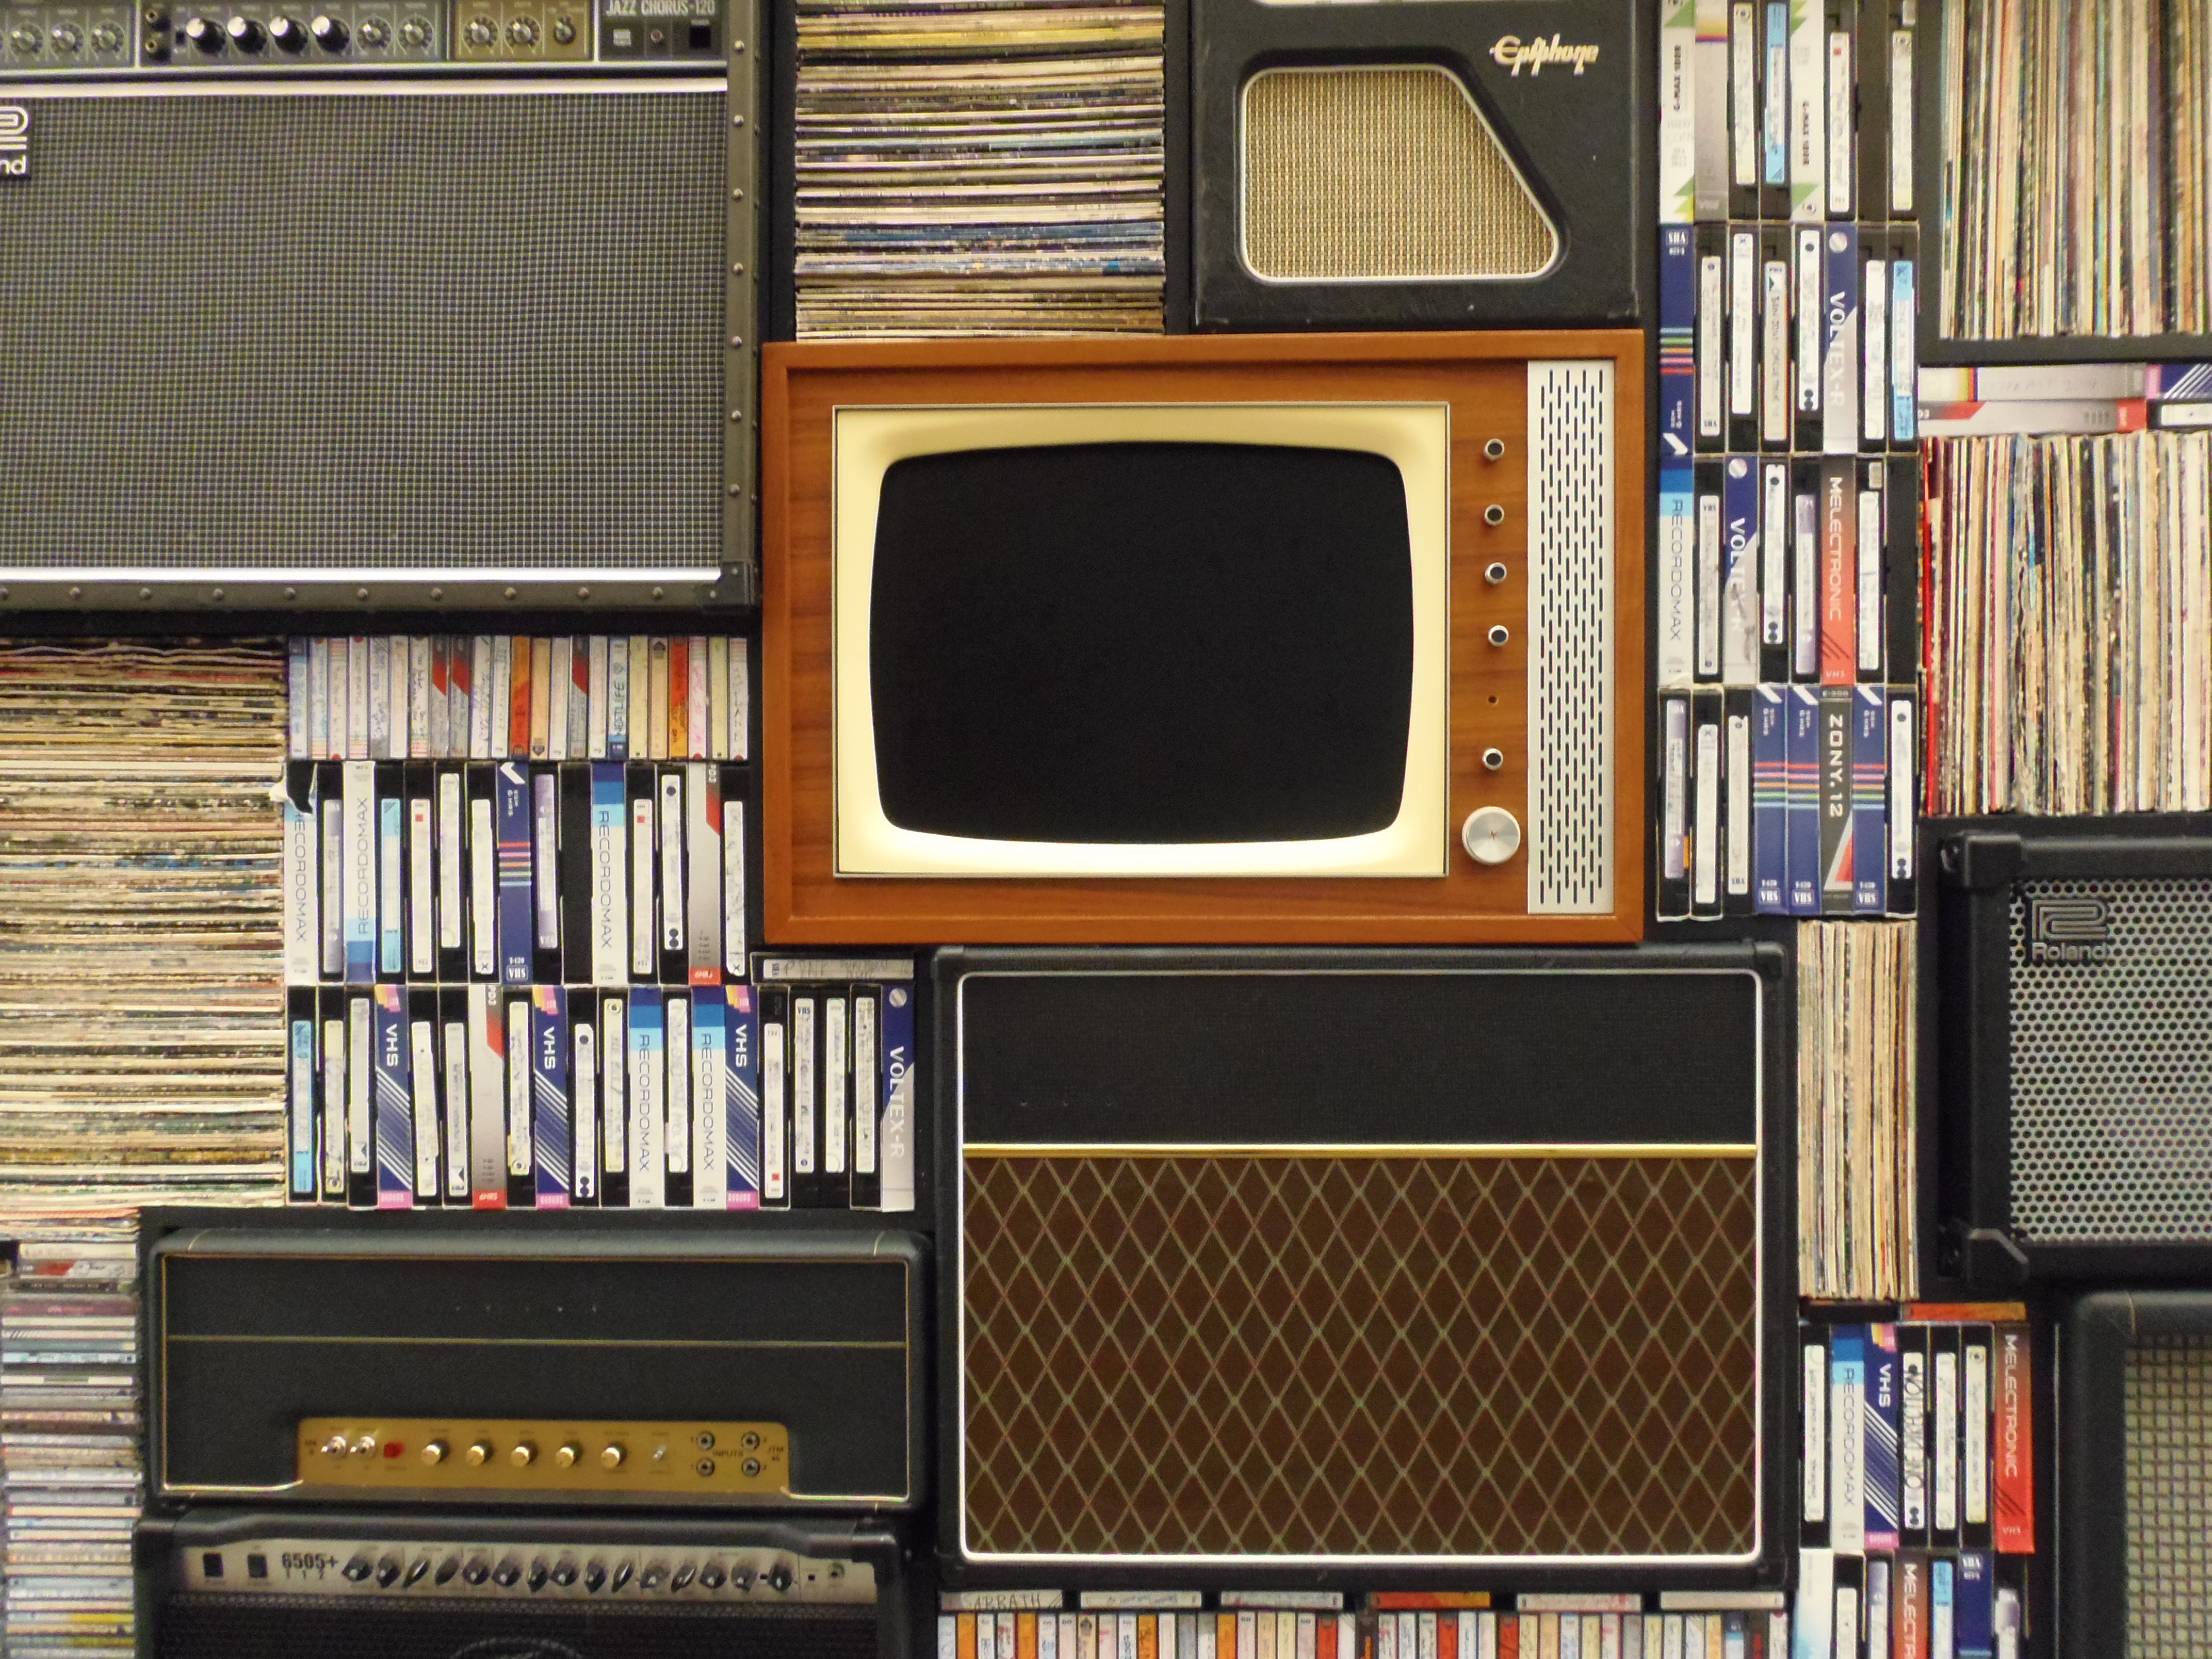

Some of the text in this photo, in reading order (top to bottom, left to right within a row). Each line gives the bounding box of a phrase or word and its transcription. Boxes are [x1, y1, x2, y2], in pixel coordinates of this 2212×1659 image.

[606, 0, 635, 16] JAZZ
[1670, 499, 1683, 641] RECORDOMAX
[1829, 477, 1842, 621] MELECTRONIC
[357, 797, 369, 934] RECORDOMAX
[598, 810, 611, 948] RECORDOMAX
[1760, 890, 1778, 901] VHS
[1794, 892, 1812, 903] VHS
[1859, 892, 1876, 903] VHS
[509, 968, 526, 978] VHS
[2032, 942, 2107, 961] Roland
[385, 1023, 398, 1067] VHS
[543, 1026, 556, 1070] VHS
[736, 1024, 747, 1068] VHS
[638, 1034, 650, 1172] RECORDOMAX
[701, 1033, 714, 1171] RECORDOMAX
[889, 1046, 905, 1159] VOLTEX-R
[1878, 1363, 1892, 1408] VHS
[2005, 1335, 2018, 1478] MELECTRONIC
[1843, 1368, 1855, 1507] RECORDOMAX
[282, 1552, 339, 1569] 6505+
